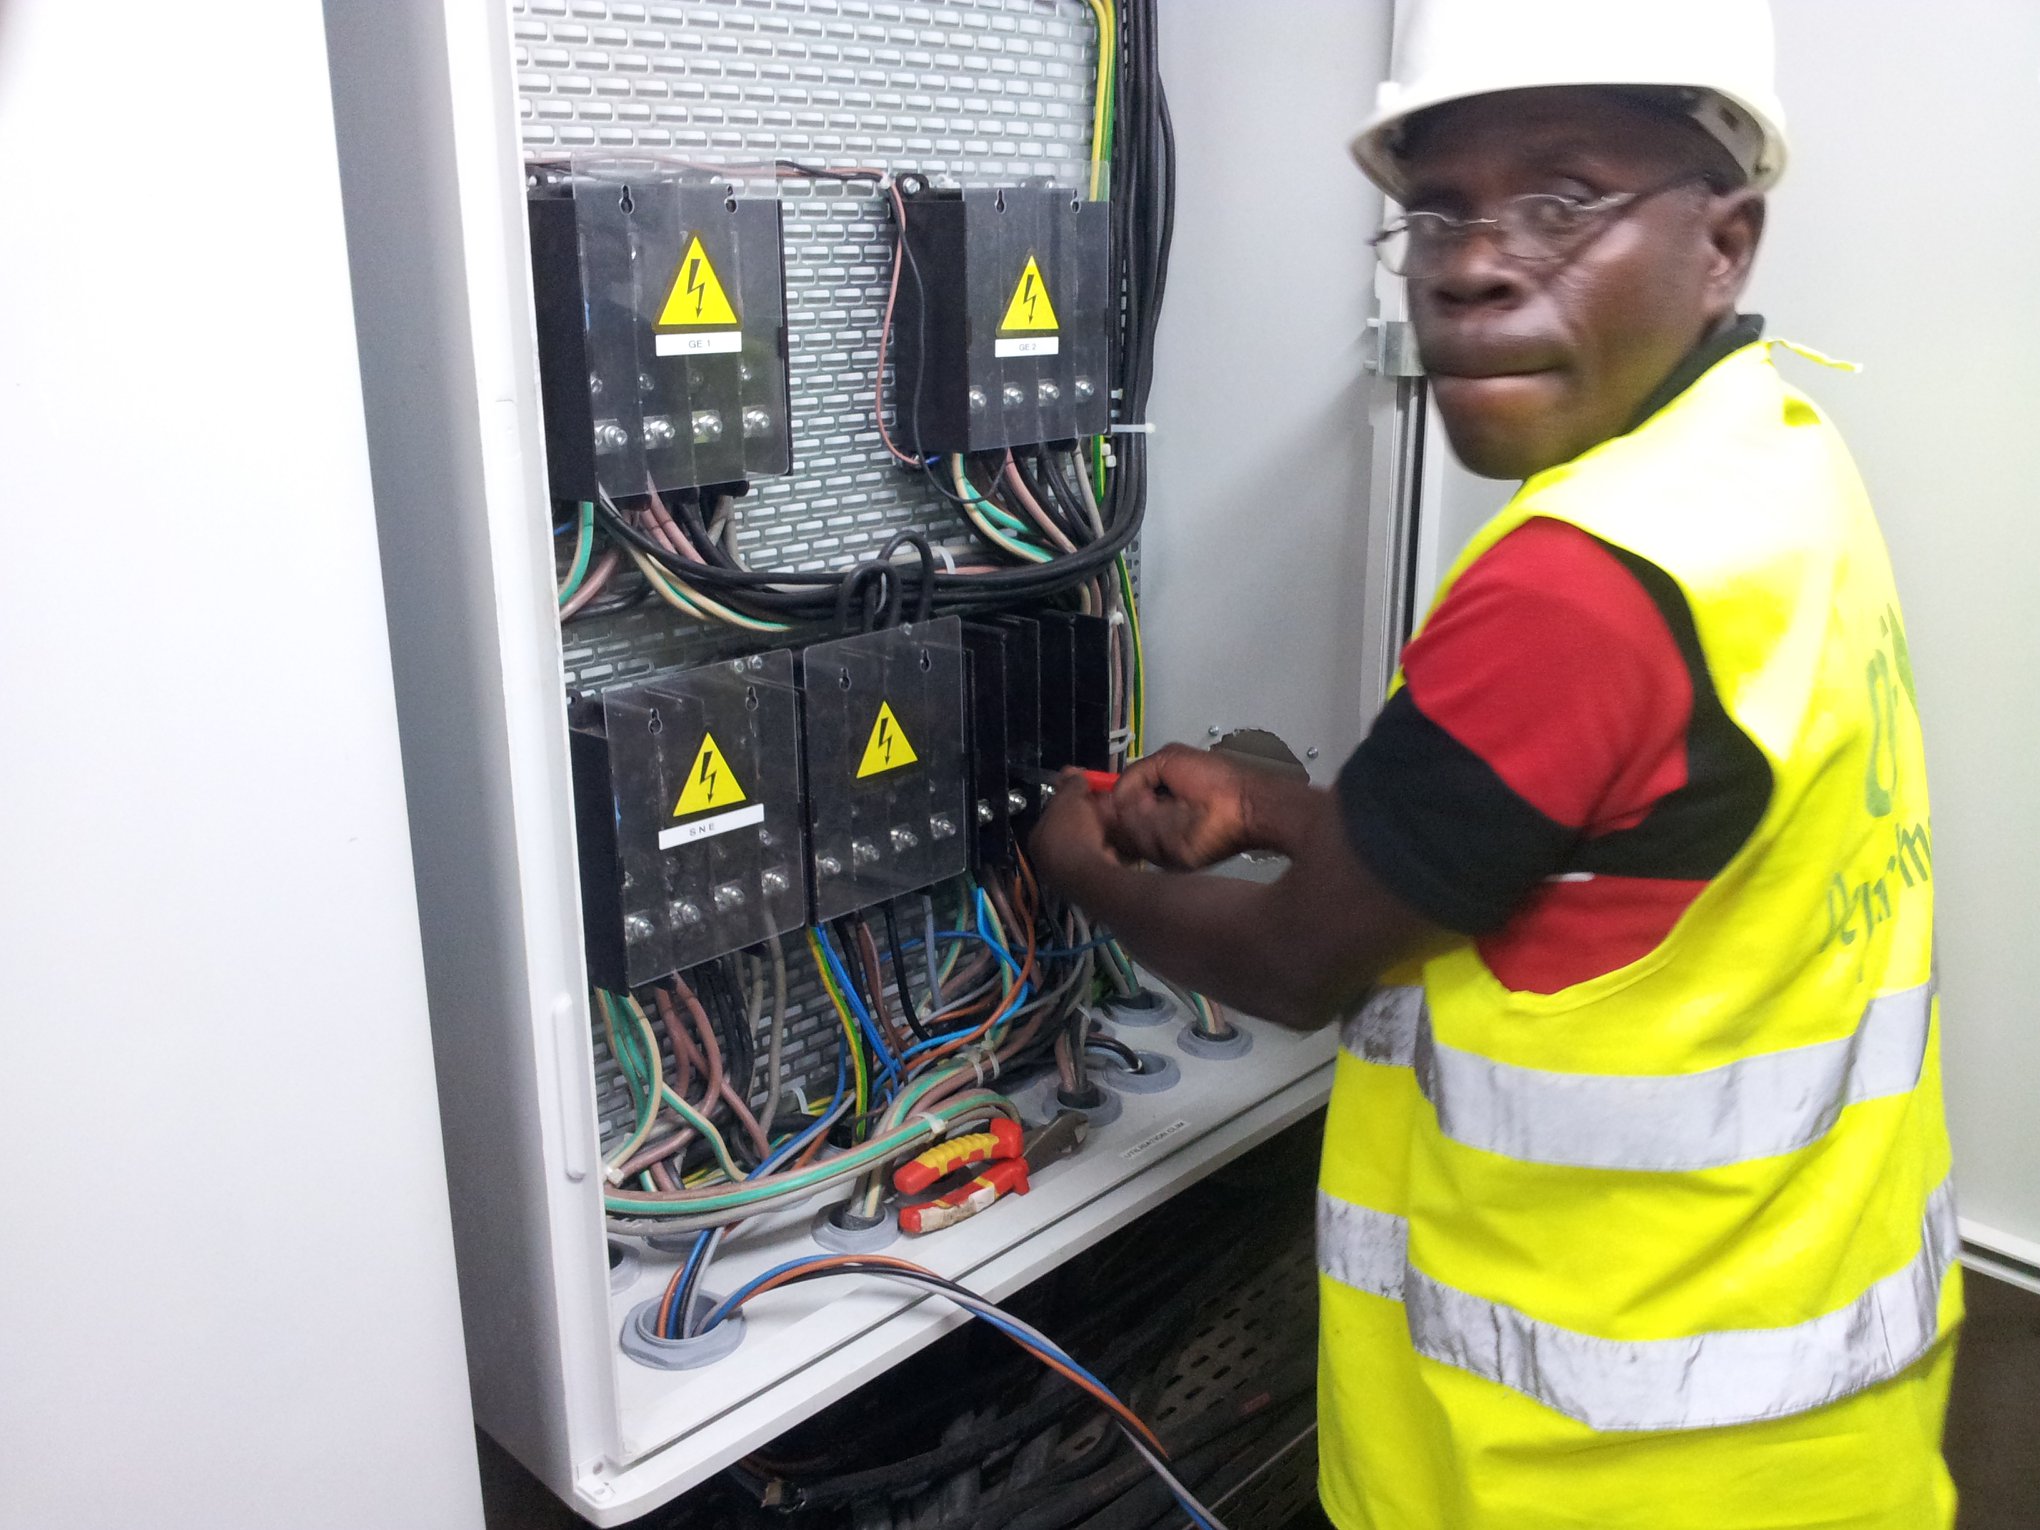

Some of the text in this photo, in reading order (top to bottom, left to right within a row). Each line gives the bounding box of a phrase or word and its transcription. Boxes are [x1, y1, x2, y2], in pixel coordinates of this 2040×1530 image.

[688, 340, 703, 349] GE
[1018, 343, 1030, 351] GE
[689, 822, 716, 837] SNE
